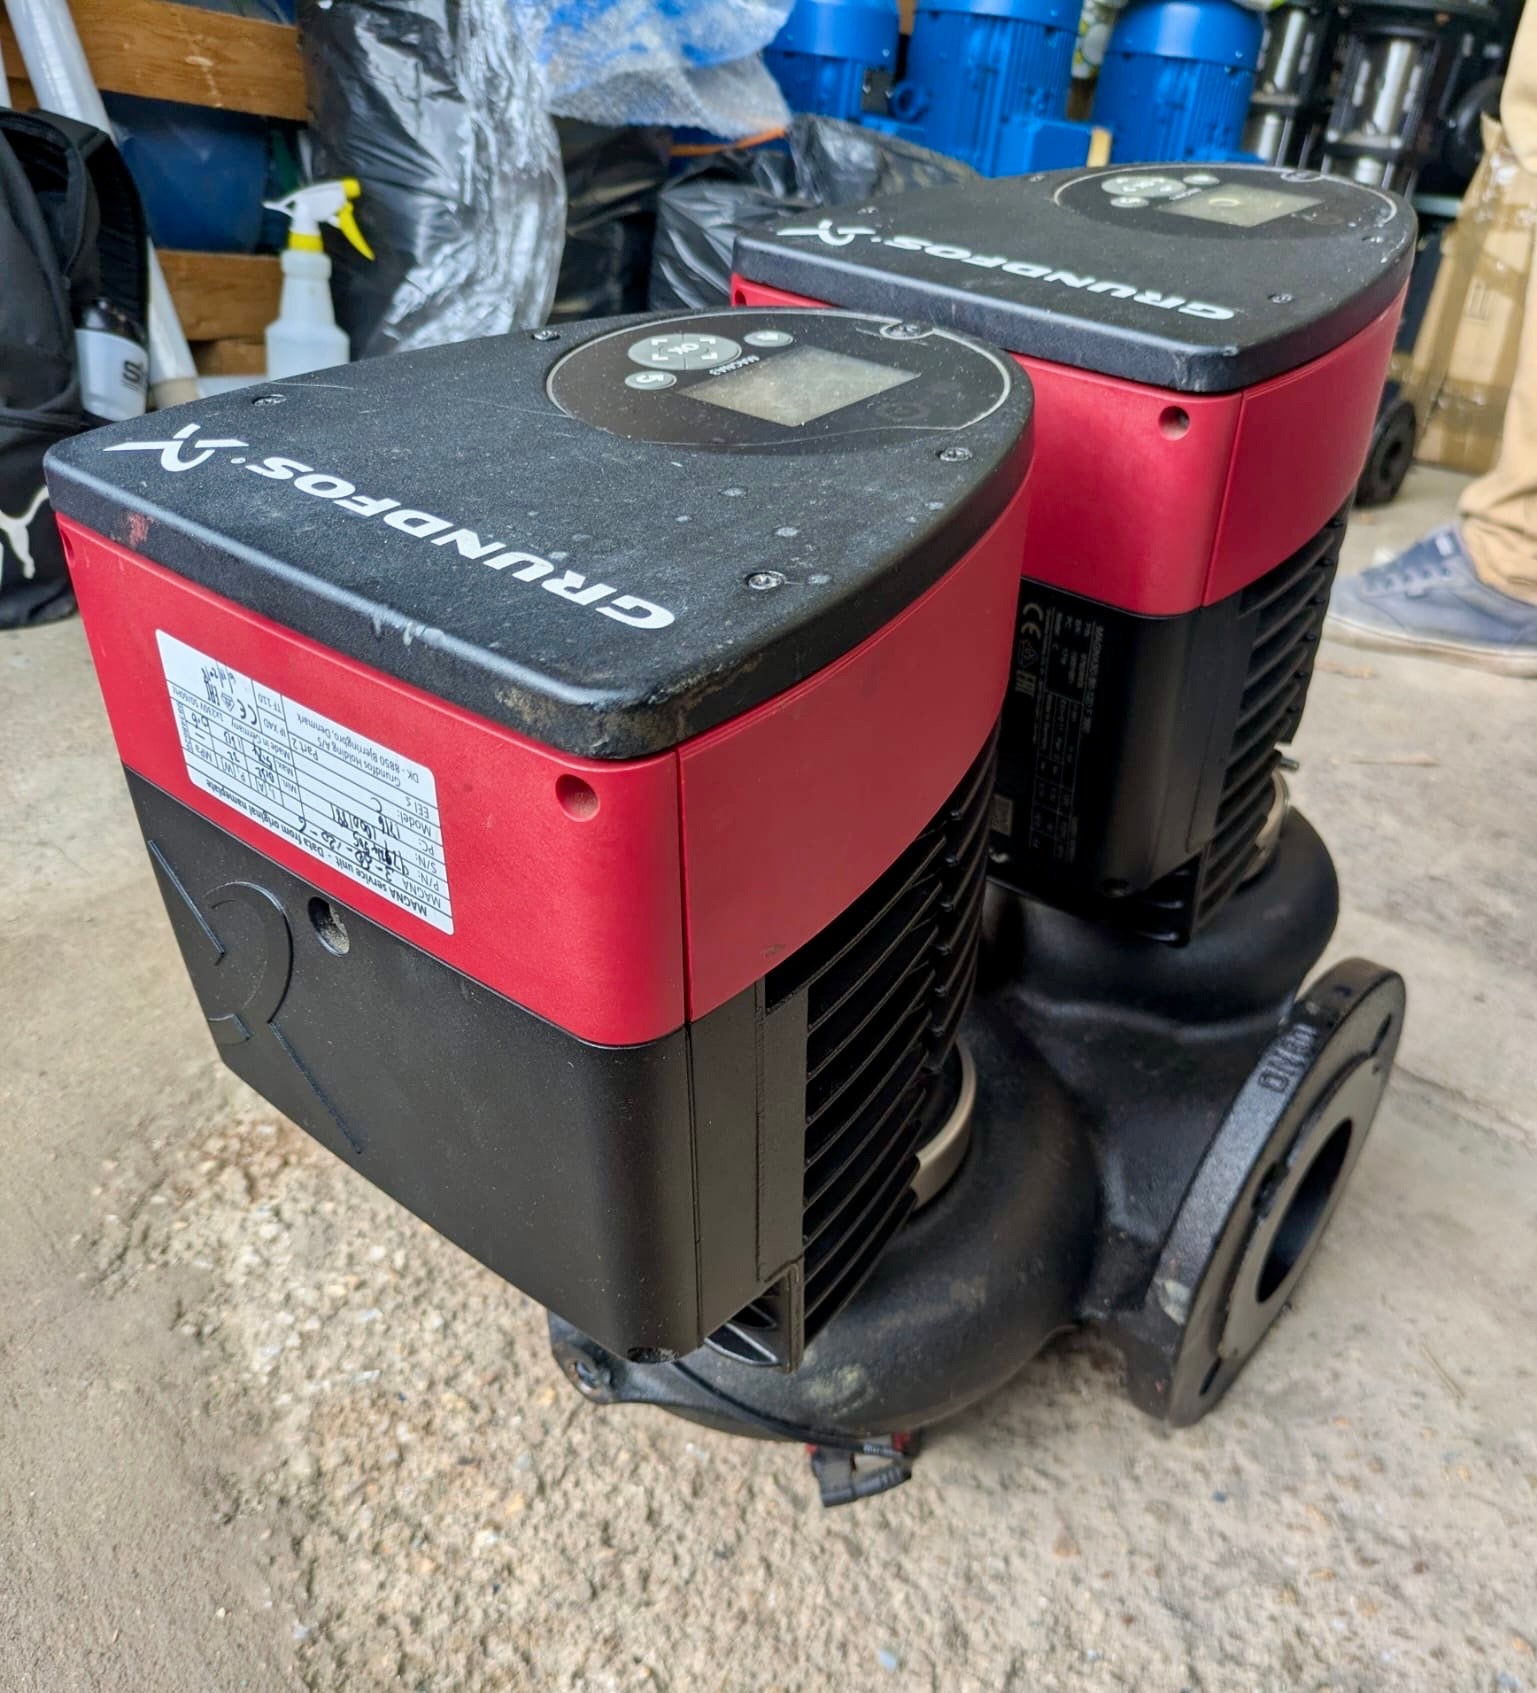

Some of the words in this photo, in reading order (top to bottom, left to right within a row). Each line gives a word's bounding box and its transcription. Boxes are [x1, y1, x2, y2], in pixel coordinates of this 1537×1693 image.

[880, 235, 1236, 321] GRUNDFOS
[245, 456, 676, 630] GRUNDFOS
[231, 719, 260, 743] Germany
[297, 714, 331, 738] Denmark
[263, 738, 270, 749] in
[271, 743, 290, 760] Made
[300, 745, 318, 761] Part
[317, 737, 330, 751] A/S
[331, 741, 362, 767] Holding
[363, 761, 400, 787] Grundfos
[380, 756, 400, 774] 8850
[407, 769, 419, 783] DK
[206, 780, 247, 810] nameplate
[370, 795, 383, 815] C
[249, 807, 279, 829] original
[413, 800, 429, 819] EEI
[281, 825, 301, 843] from
[396, 812, 431, 836] Model:
[303, 838, 324, 857] Data
[417, 836, 434, 856] PC:
[335, 857, 353, 874] unit
[415, 853, 436, 872] S/N:
[356, 869, 387, 891] service
[419, 870, 439, 889] P/N:
[389, 888, 427, 917] MAGNA
[403, 878, 441, 908] MAGNA
